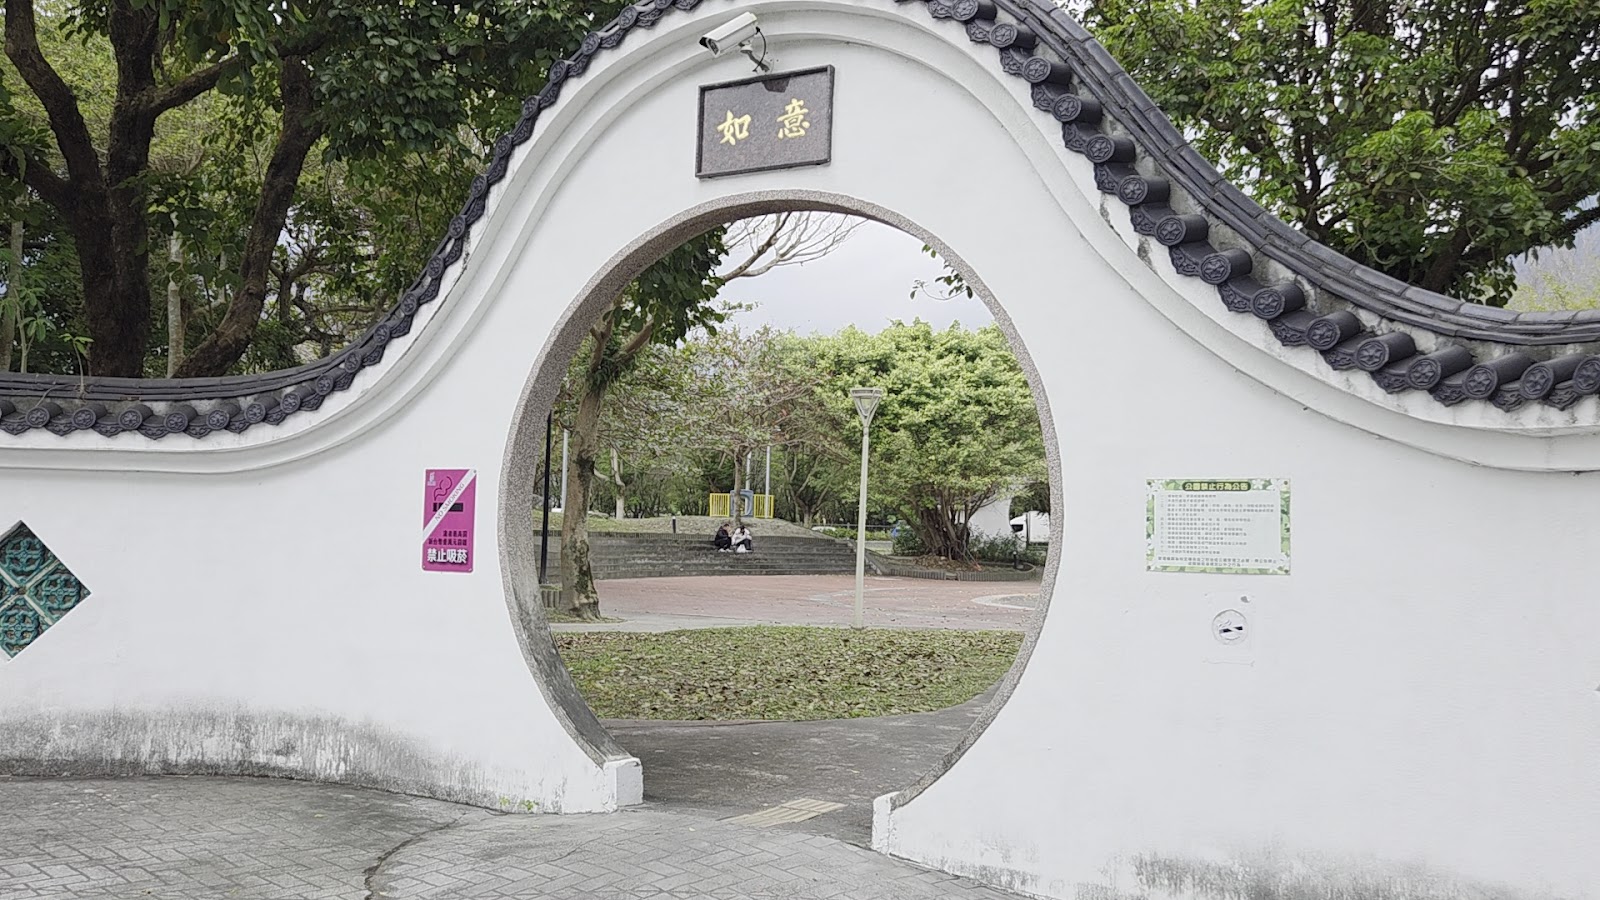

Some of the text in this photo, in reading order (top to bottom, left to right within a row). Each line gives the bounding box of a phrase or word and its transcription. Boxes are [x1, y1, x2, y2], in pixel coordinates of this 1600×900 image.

[717, 98, 810, 145] 如意
[1185, 482, 1249, 491] 公園禁止行為公告
[434, 483, 465, 521] NO SMOKING
[427, 548, 467, 564] 禁止吸菸
